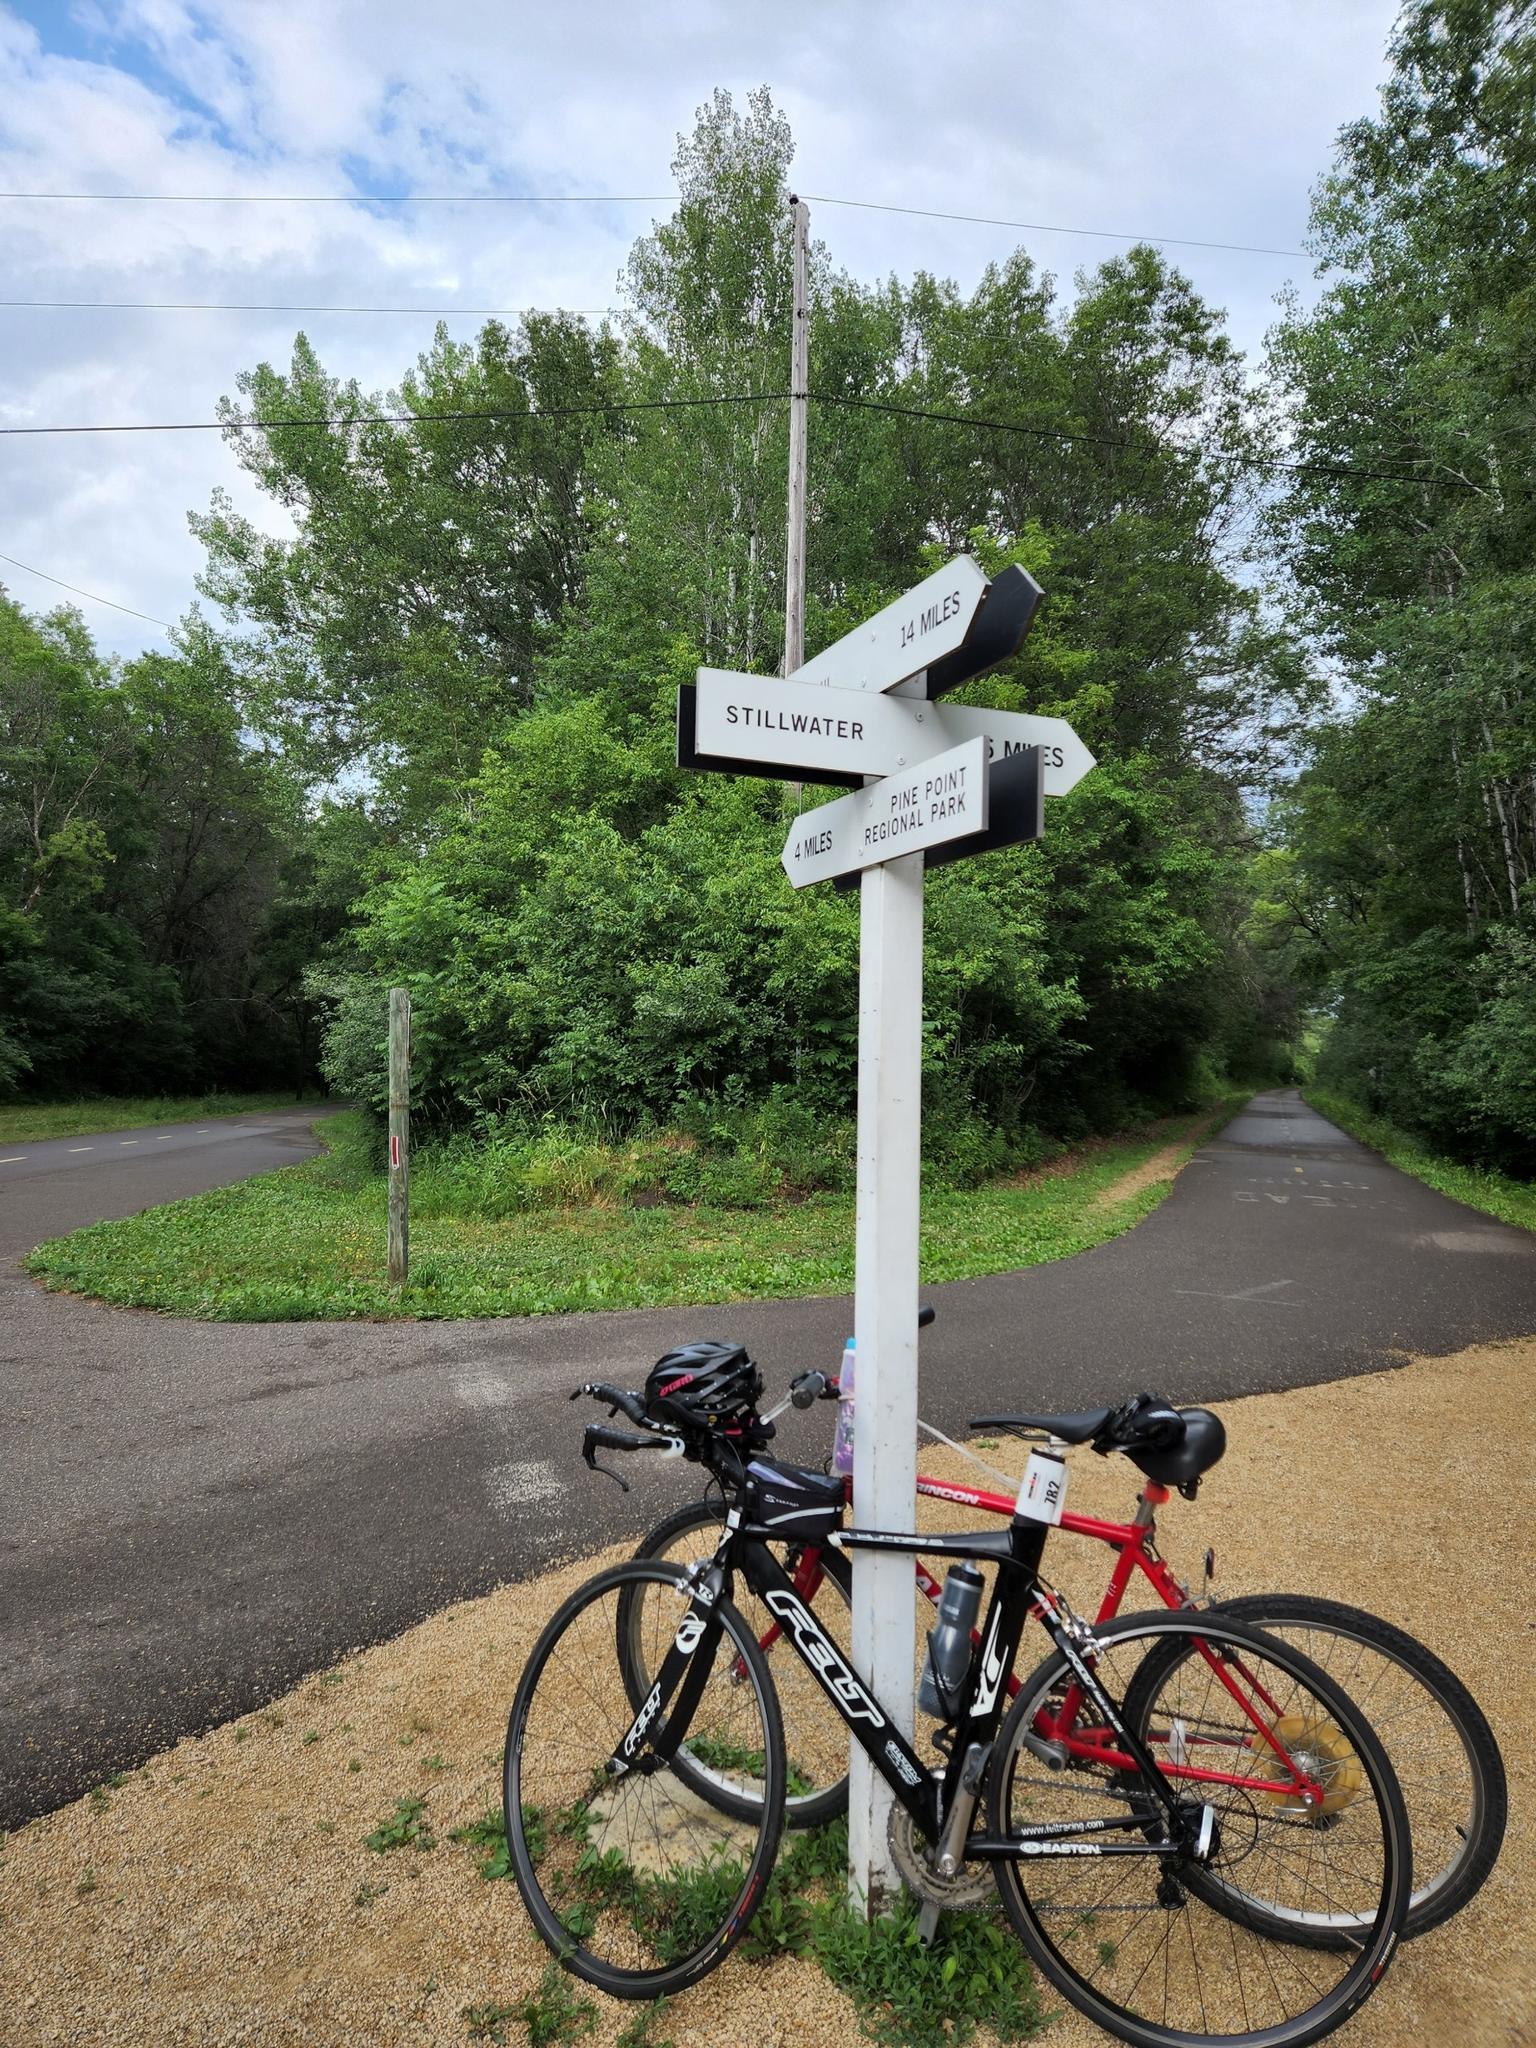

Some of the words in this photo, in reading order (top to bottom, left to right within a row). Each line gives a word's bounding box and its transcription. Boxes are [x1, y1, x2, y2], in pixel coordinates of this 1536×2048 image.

[901, 619, 915, 648] 14
[921, 591, 961, 636] MILES
[726, 705, 864, 741] STILLWATER
[890, 786, 918, 814] PINE
[925, 767, 967, 801] POINT
[864, 809, 924, 846] REGIONAL
[930, 792, 966, 823] PARK
[795, 842, 801, 862] 4
[804, 830, 833, 859] MILES
[1042, 1843, 1101, 1855] EASTON
